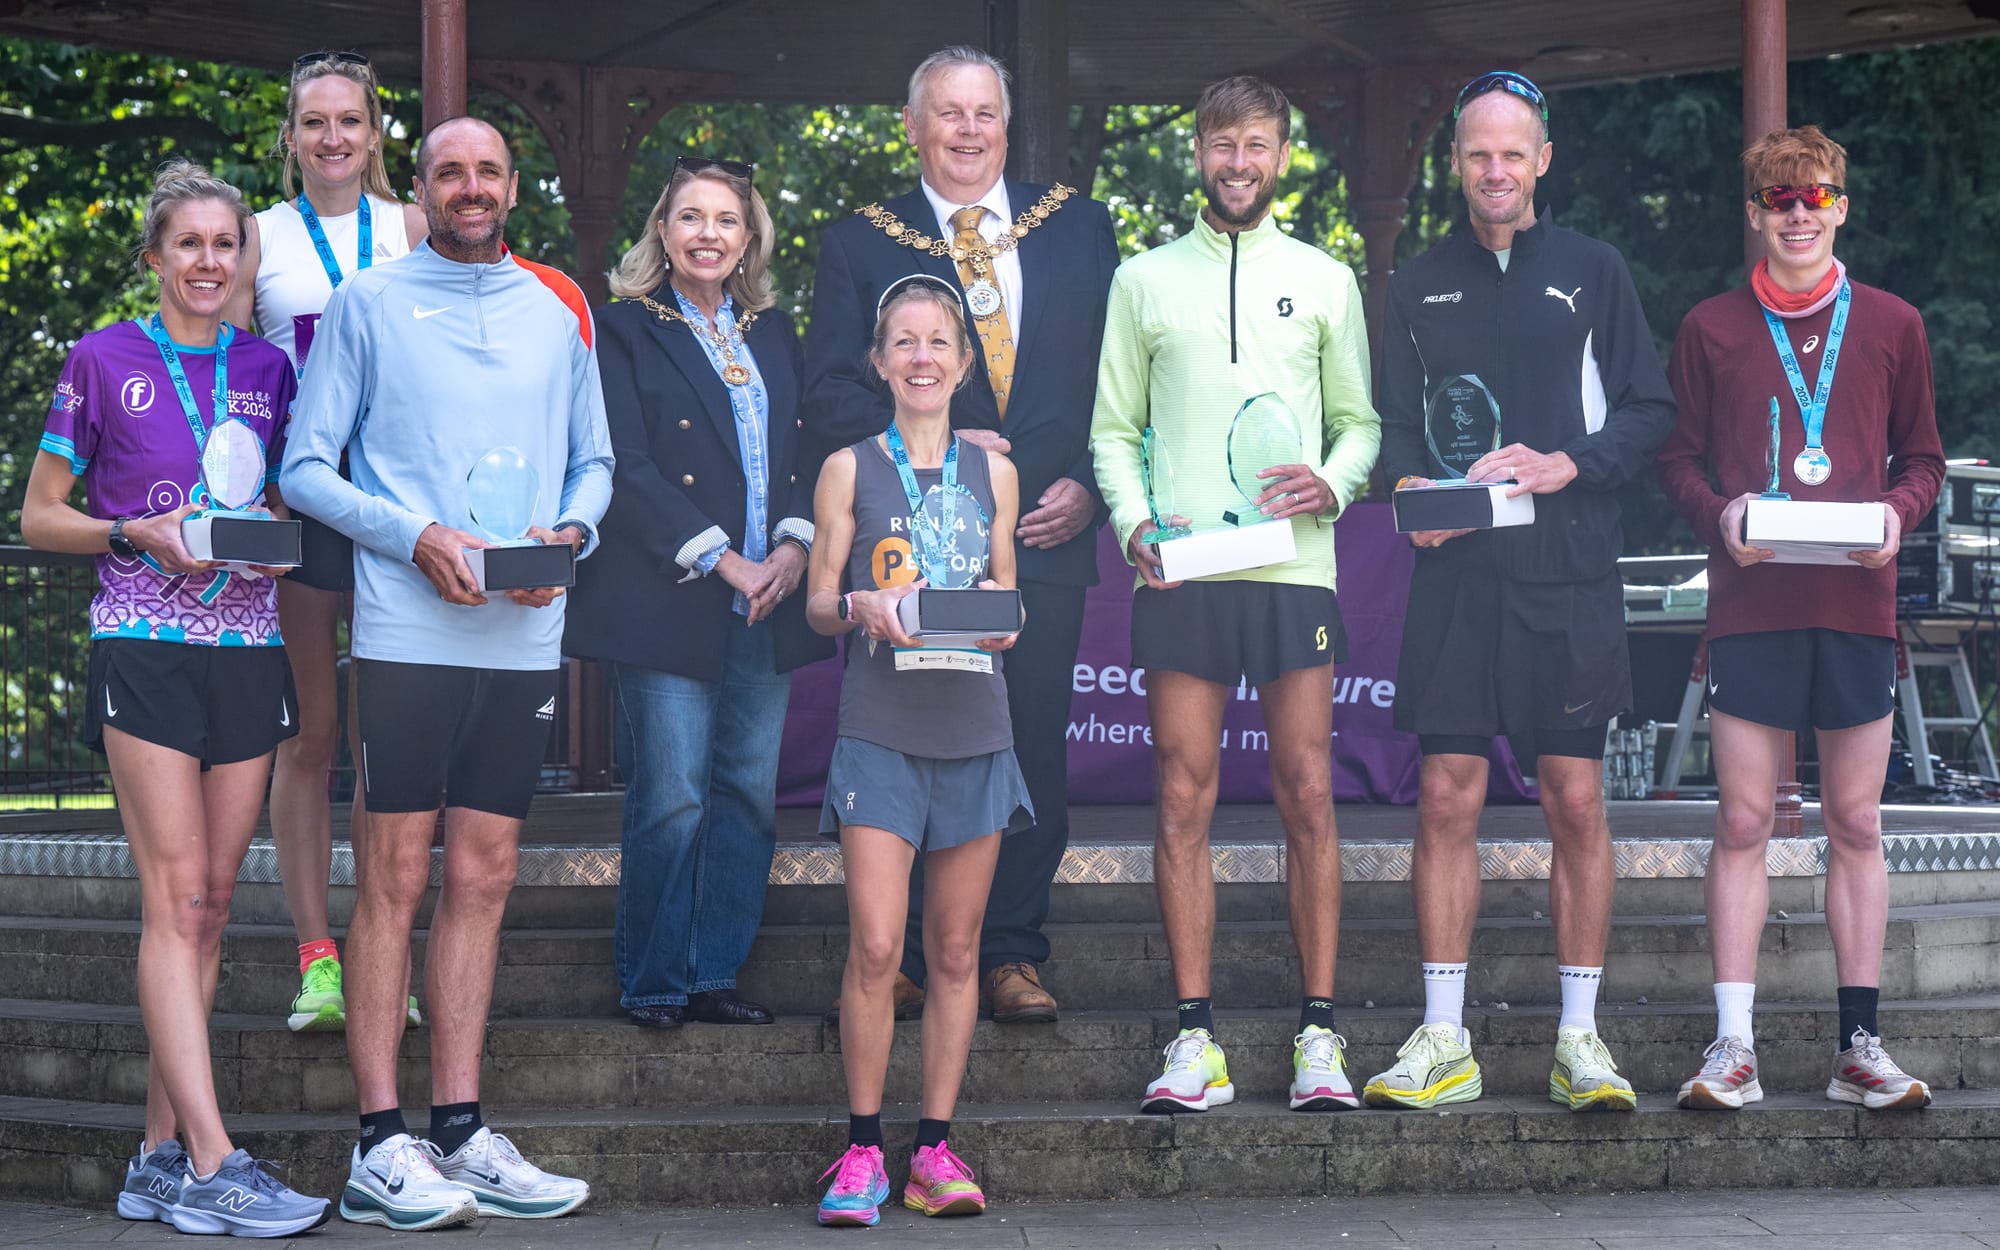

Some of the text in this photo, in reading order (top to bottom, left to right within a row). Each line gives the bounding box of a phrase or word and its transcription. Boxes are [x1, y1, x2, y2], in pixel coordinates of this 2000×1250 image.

[305, 211, 318, 230] 2026
[161, 341, 176, 364] 2026
[1823, 349, 1836, 371] 2026
[211, 388, 254, 401] Sfford
[1795, 386, 1810, 408] 2026
[241, 400, 272, 420] 2026
[1309, 1001, 1333, 1010] RC
[148, 1174, 175, 1199] N
[216, 1187, 258, 1212] N
